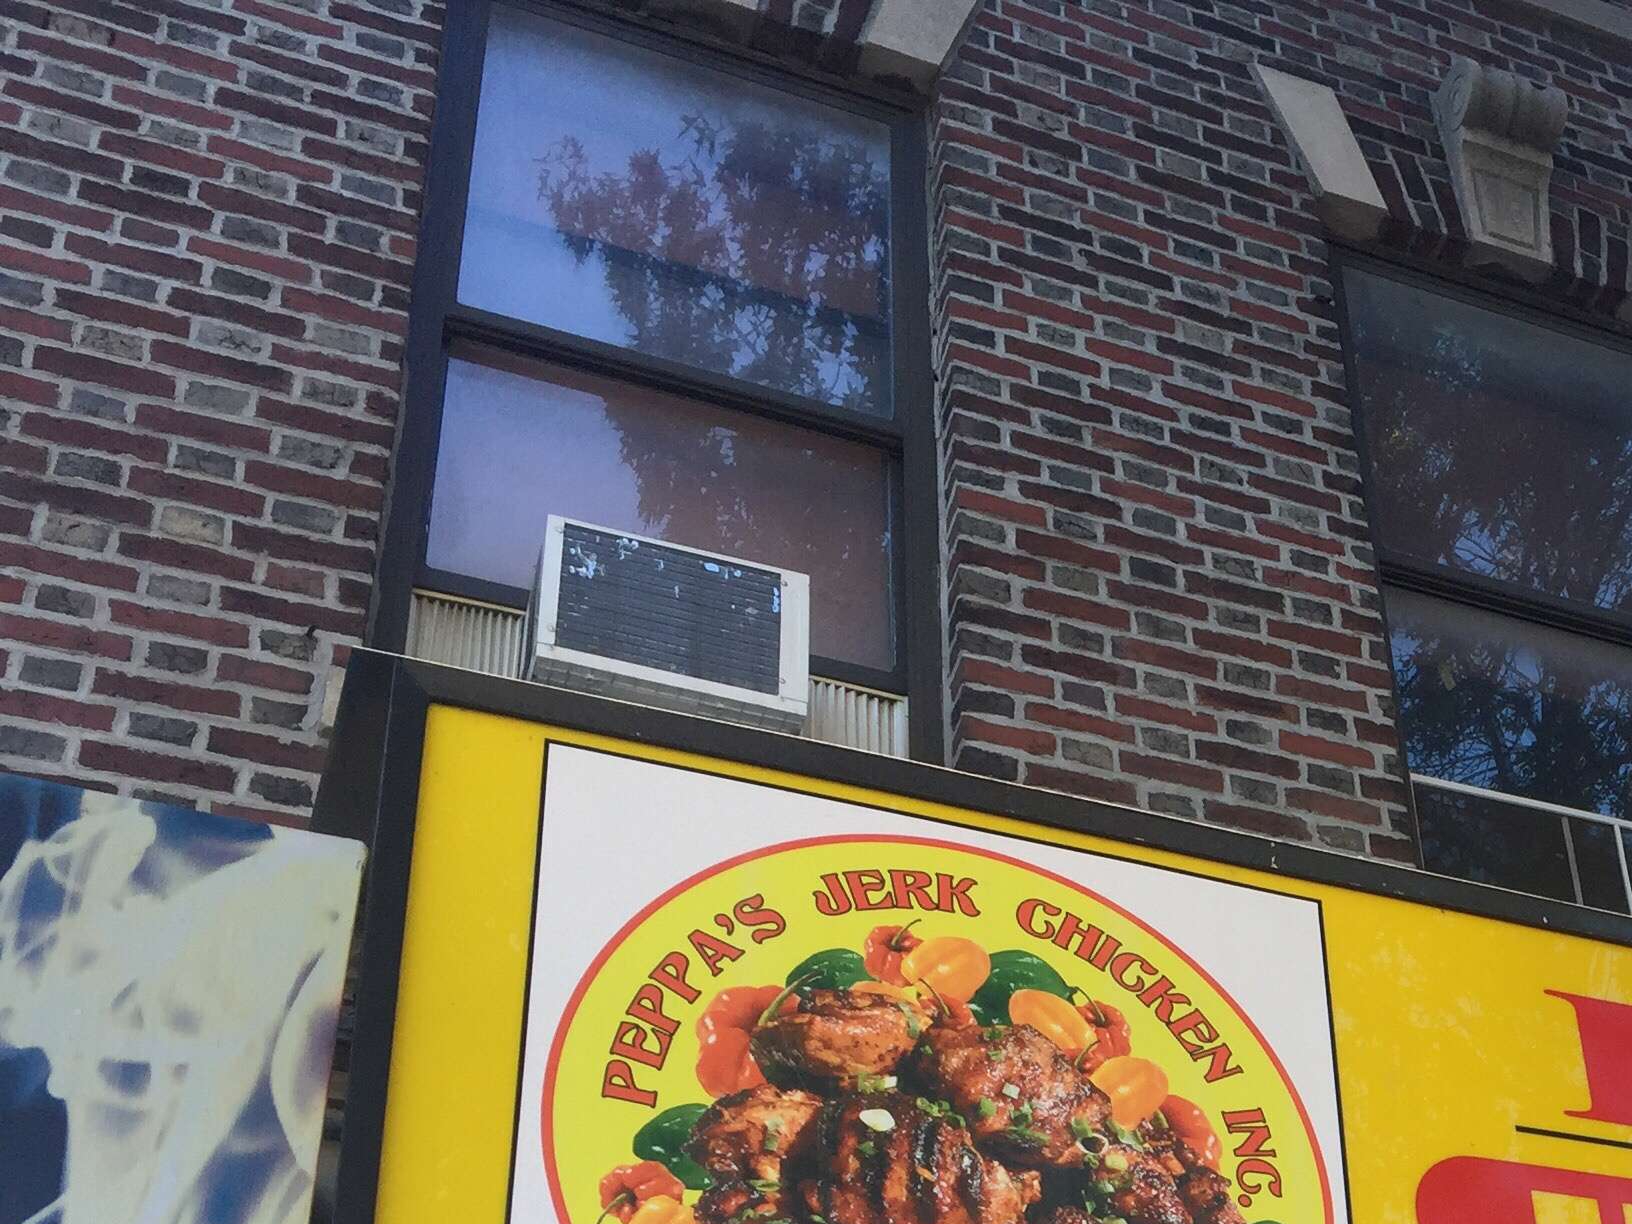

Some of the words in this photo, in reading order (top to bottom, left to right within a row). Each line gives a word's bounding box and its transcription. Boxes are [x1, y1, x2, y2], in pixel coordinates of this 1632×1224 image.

[602, 894, 787, 1109] PEPPA'S
[812, 868, 981, 918] JERK
[1015, 897, 1243, 1084] CHICKEN
[1220, 1106, 1283, 1208] INC.
